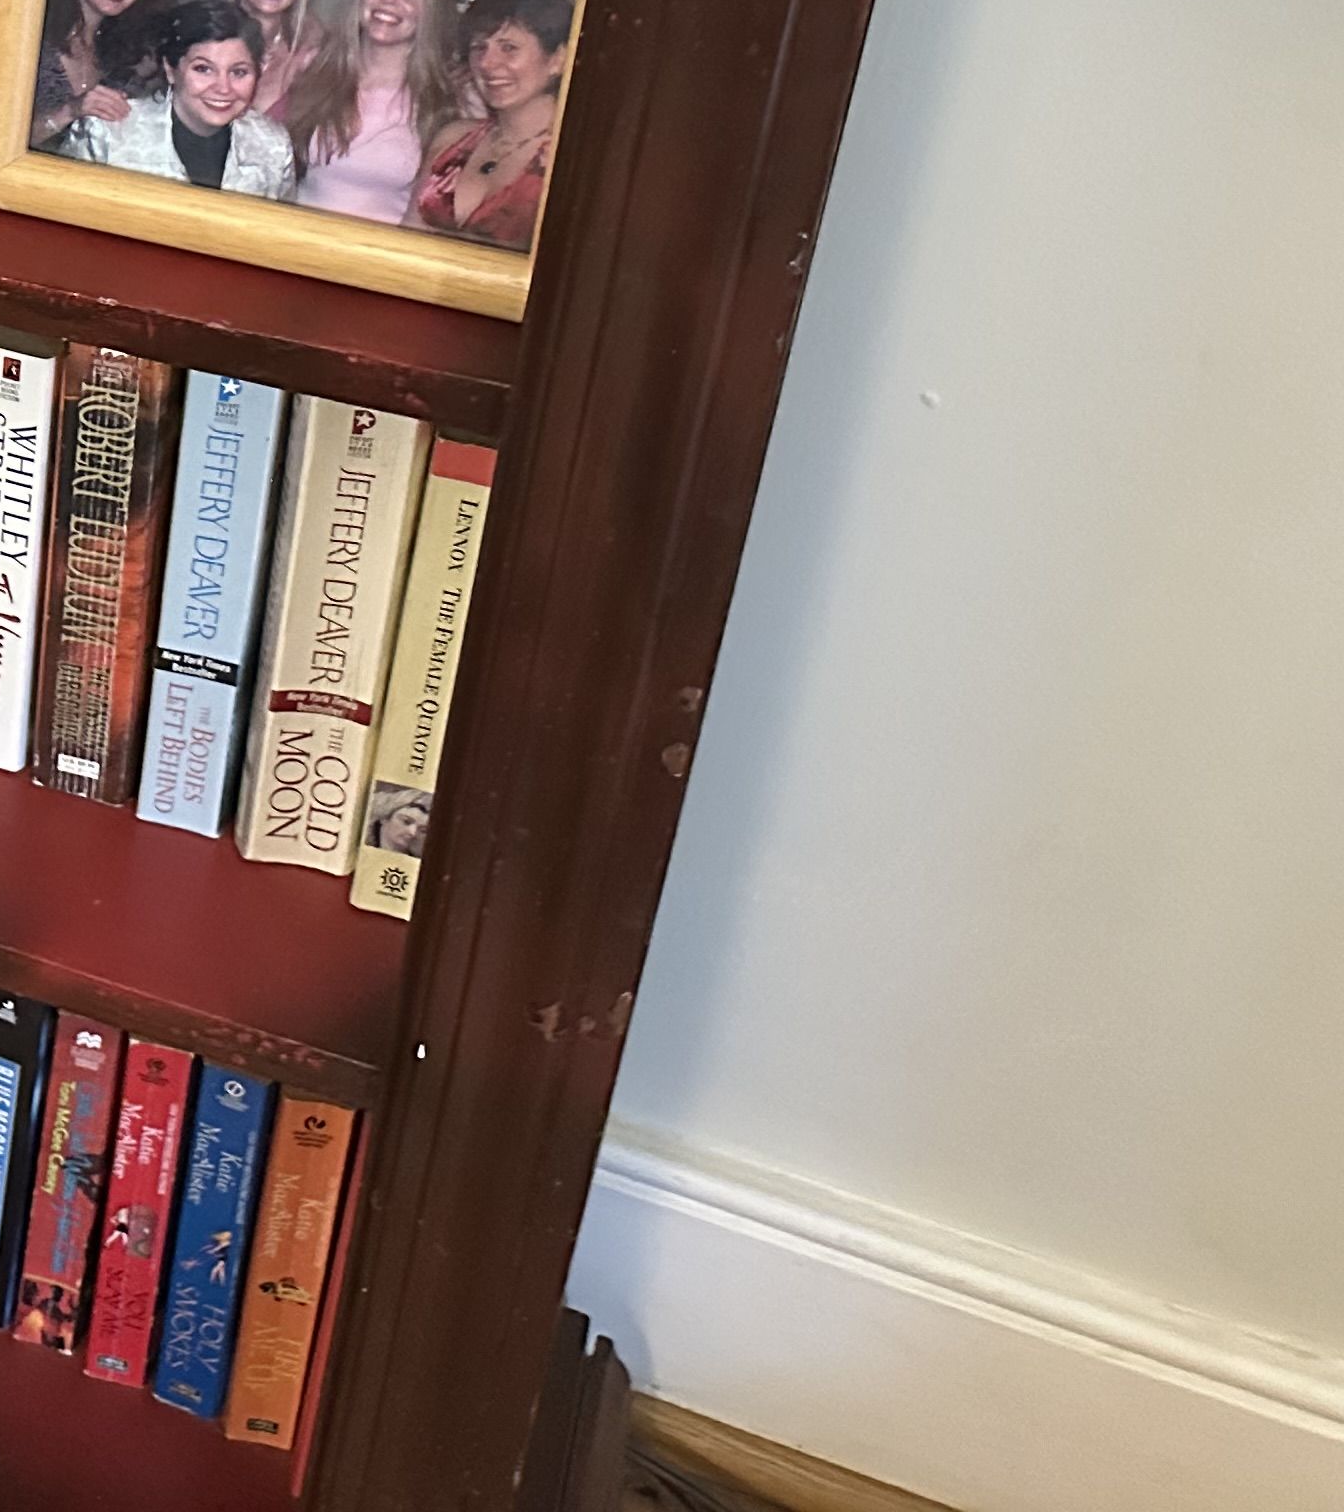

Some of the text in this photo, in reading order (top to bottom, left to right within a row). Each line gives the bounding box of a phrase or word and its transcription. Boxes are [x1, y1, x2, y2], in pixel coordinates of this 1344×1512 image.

[0, 424, 37, 568] WHITLEY
[184, 424, 244, 640] JEFFERY DEAVER
[310, 465, 375, 685] JEFFERY DEAVER
[408, 498, 479, 775] LENNOX QUIXOTE
[266, 729, 312, 841] MOON
[305, 756, 349, 853] COLD
